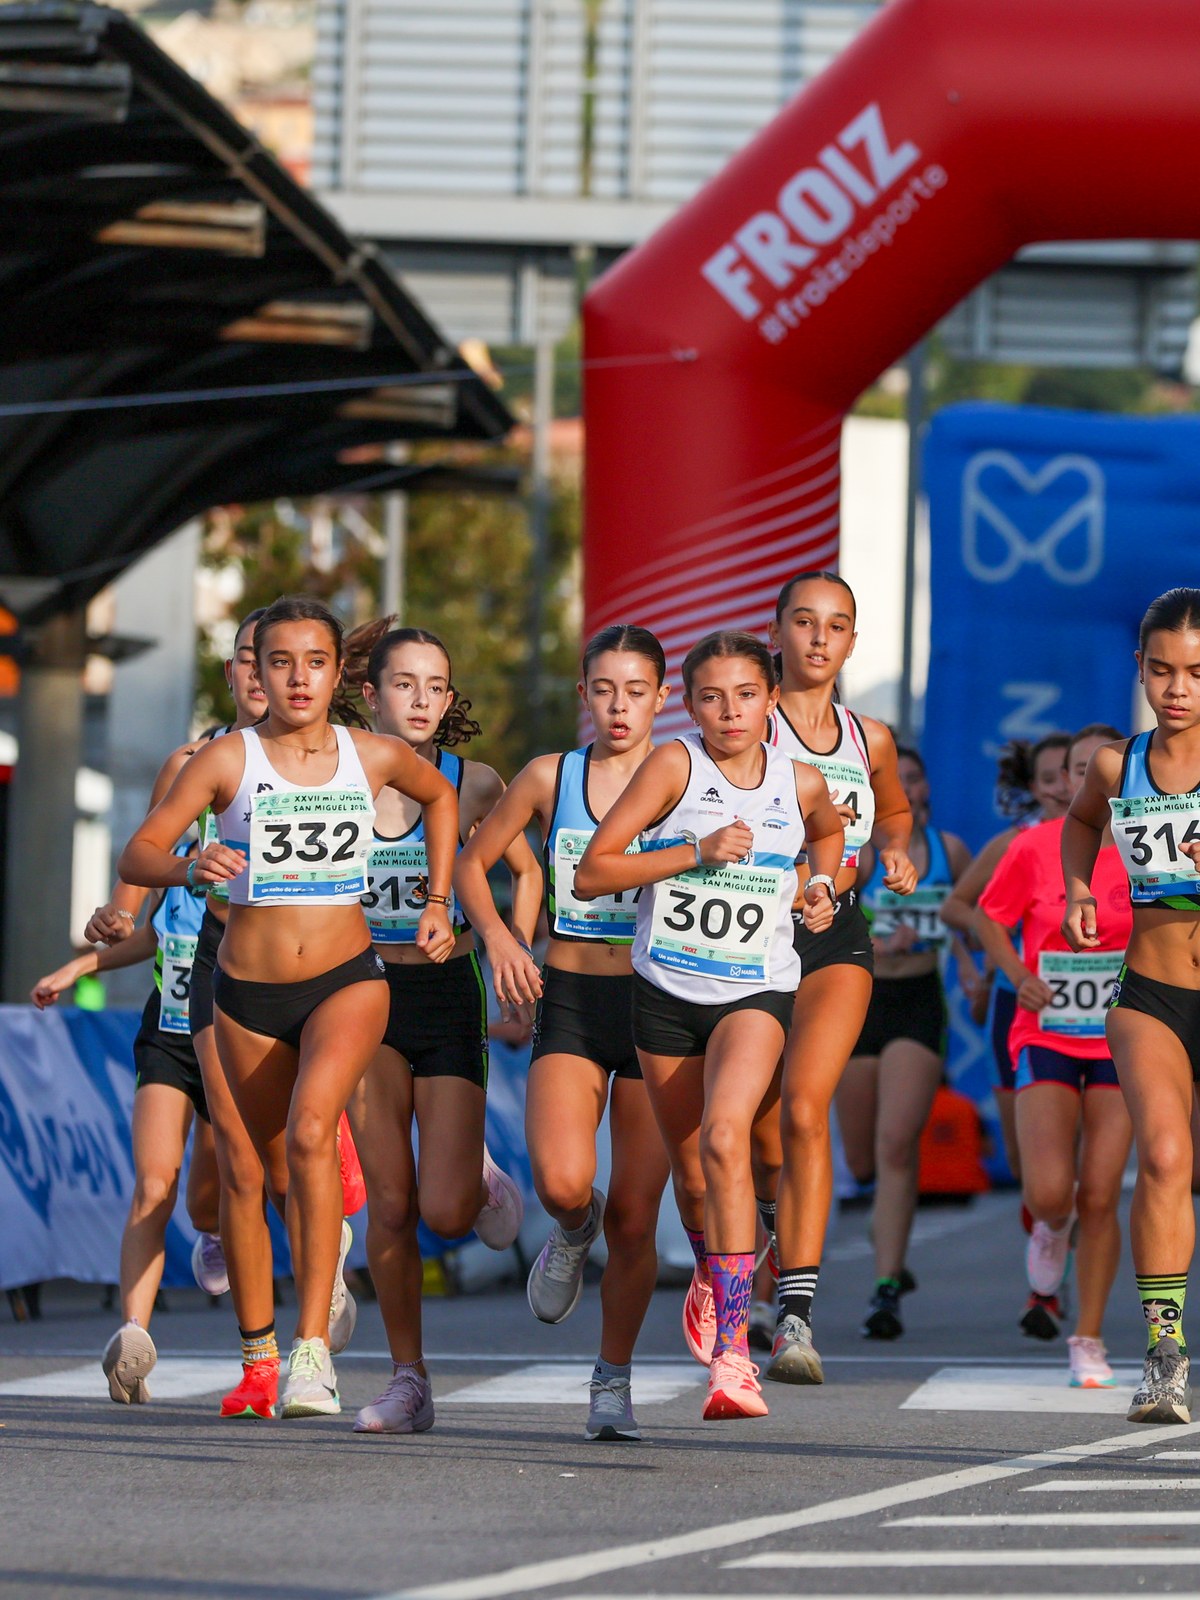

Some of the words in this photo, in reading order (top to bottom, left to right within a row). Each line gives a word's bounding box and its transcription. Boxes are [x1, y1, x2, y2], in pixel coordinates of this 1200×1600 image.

[702, 102, 921, 321] FROIZ
[758, 165, 948, 344] #froizdeporte
[314, 804, 347, 812] MIGUEL
[339, 793, 364, 801] Urbana
[1144, 794, 1168, 804] XXVII
[1144, 806, 1161, 814] SAN
[1163, 803, 1195, 811] MIGUEL
[262, 821, 359, 864] 332
[702, 878, 721, 887] SAN
[723, 882, 755, 892] MIGUEL
[757, 886, 775, 894] 2026
[704, 868, 731, 879] XXVII
[749, 875, 776, 884] Urbana
[360, 876, 429, 910] 313
[663, 889, 764, 944] 309
[1048, 980, 1116, 1009] 302
